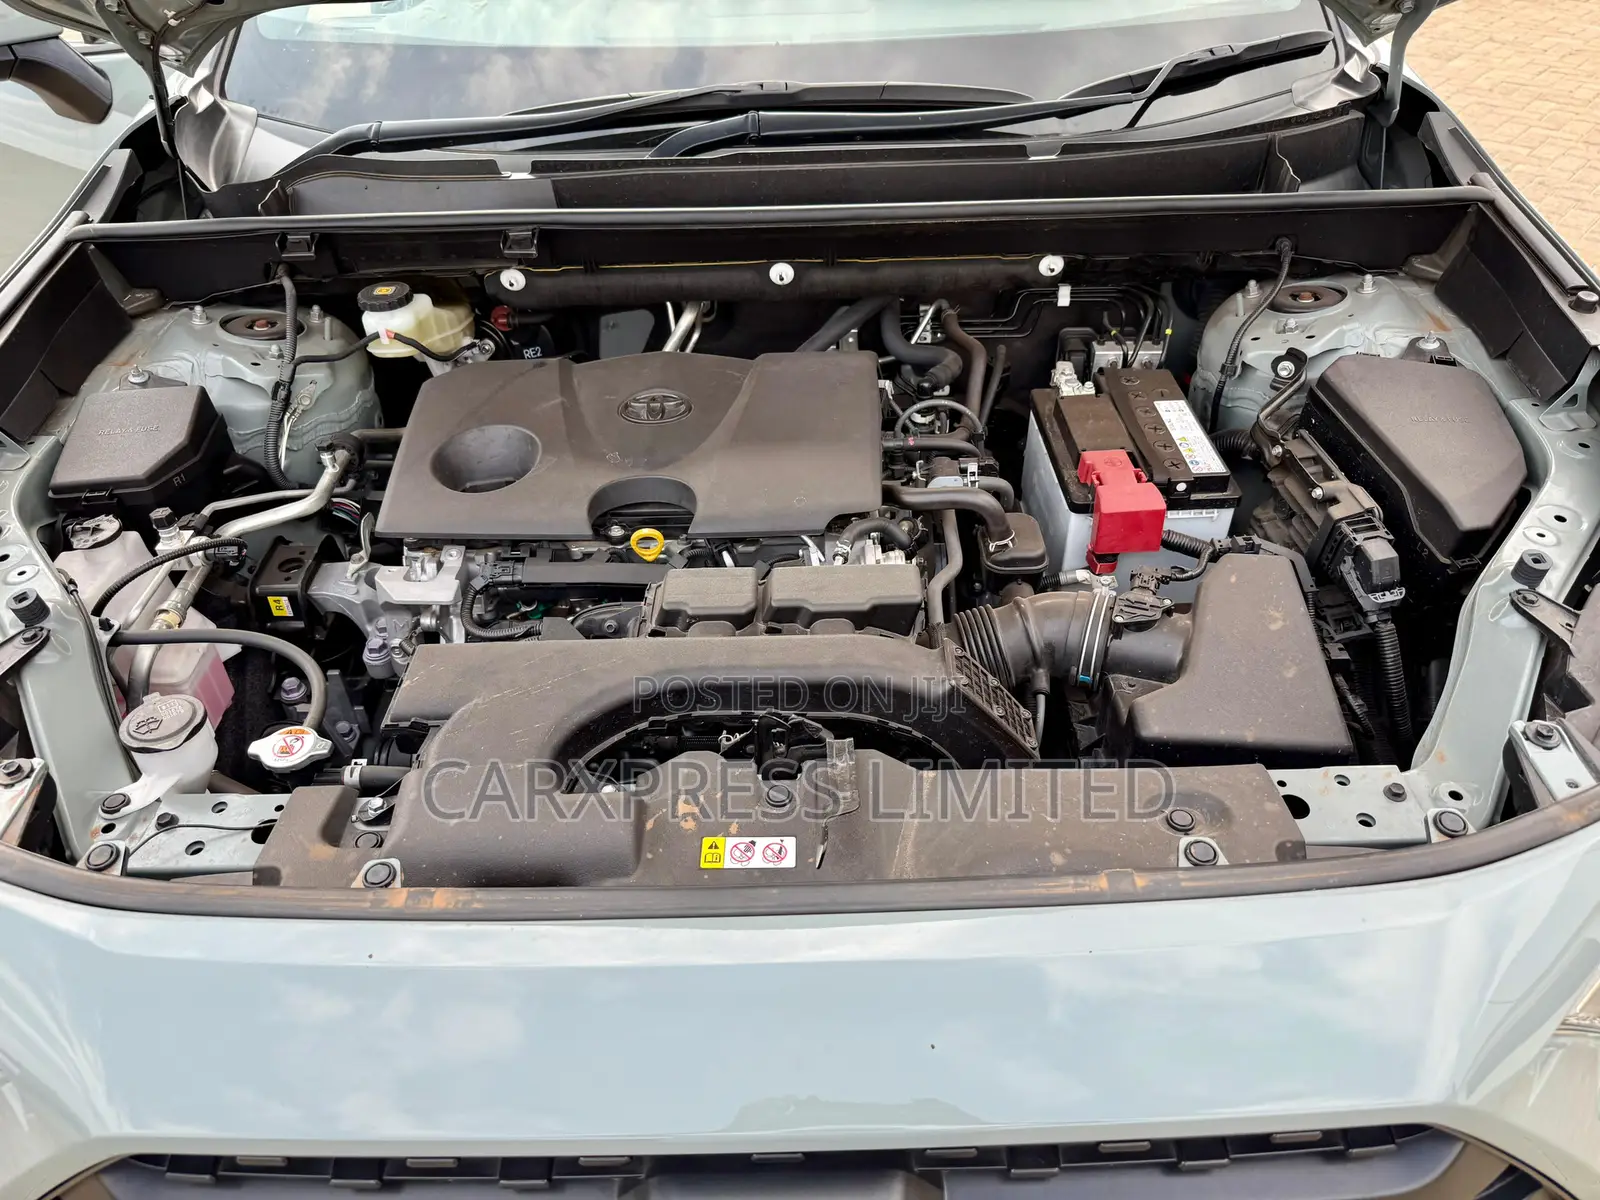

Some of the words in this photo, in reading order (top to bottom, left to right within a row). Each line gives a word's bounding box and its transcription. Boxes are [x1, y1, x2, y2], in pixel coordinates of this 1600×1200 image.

[523, 346, 543, 360] RE2
[172, 472, 186, 487] R1
[272, 599, 285, 611] R4
